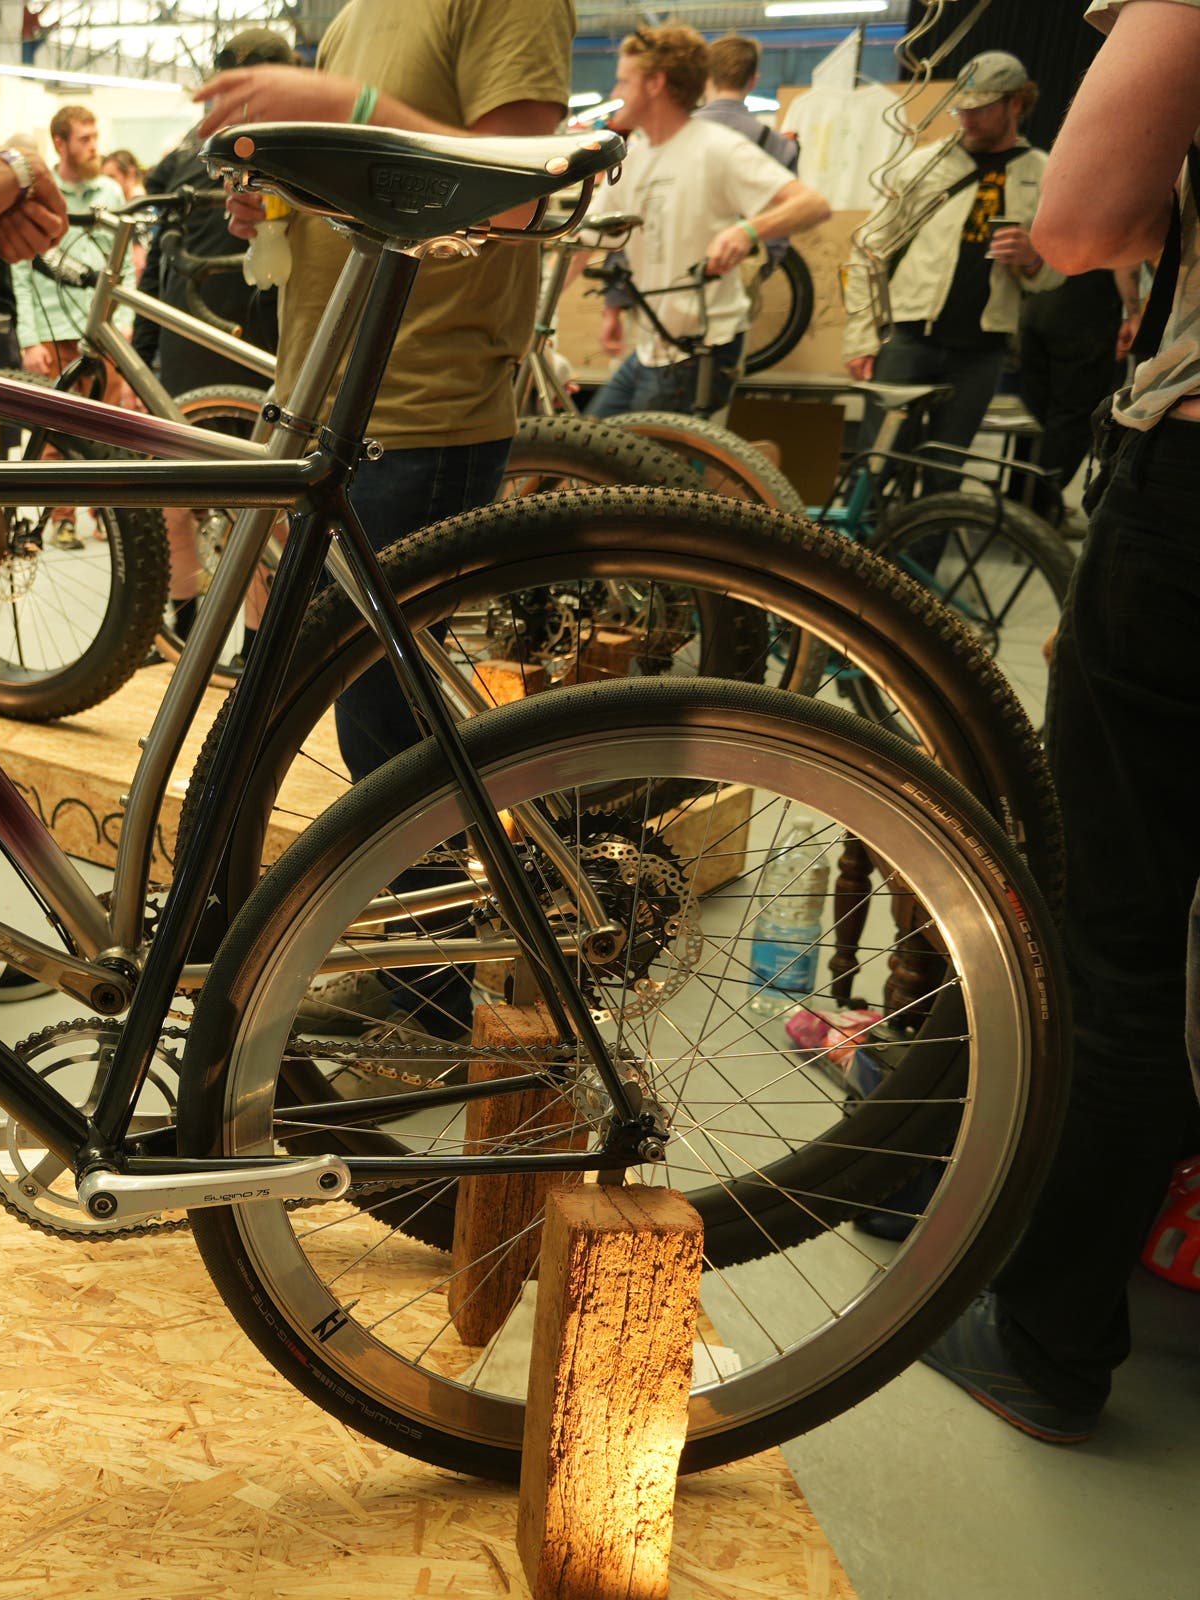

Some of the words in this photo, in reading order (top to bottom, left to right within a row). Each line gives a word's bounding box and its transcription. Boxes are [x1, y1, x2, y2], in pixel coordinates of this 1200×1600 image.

[377, 171, 449, 195] BROOKS
[900, 781, 988, 858] SCHWALBE
[1019, 920, 1045, 978] G-ONE
[256, 1188, 270, 1197] 75
[252, 1293, 287, 1342] G-ONE
[334, 1382, 423, 1440] SCHWALBE
